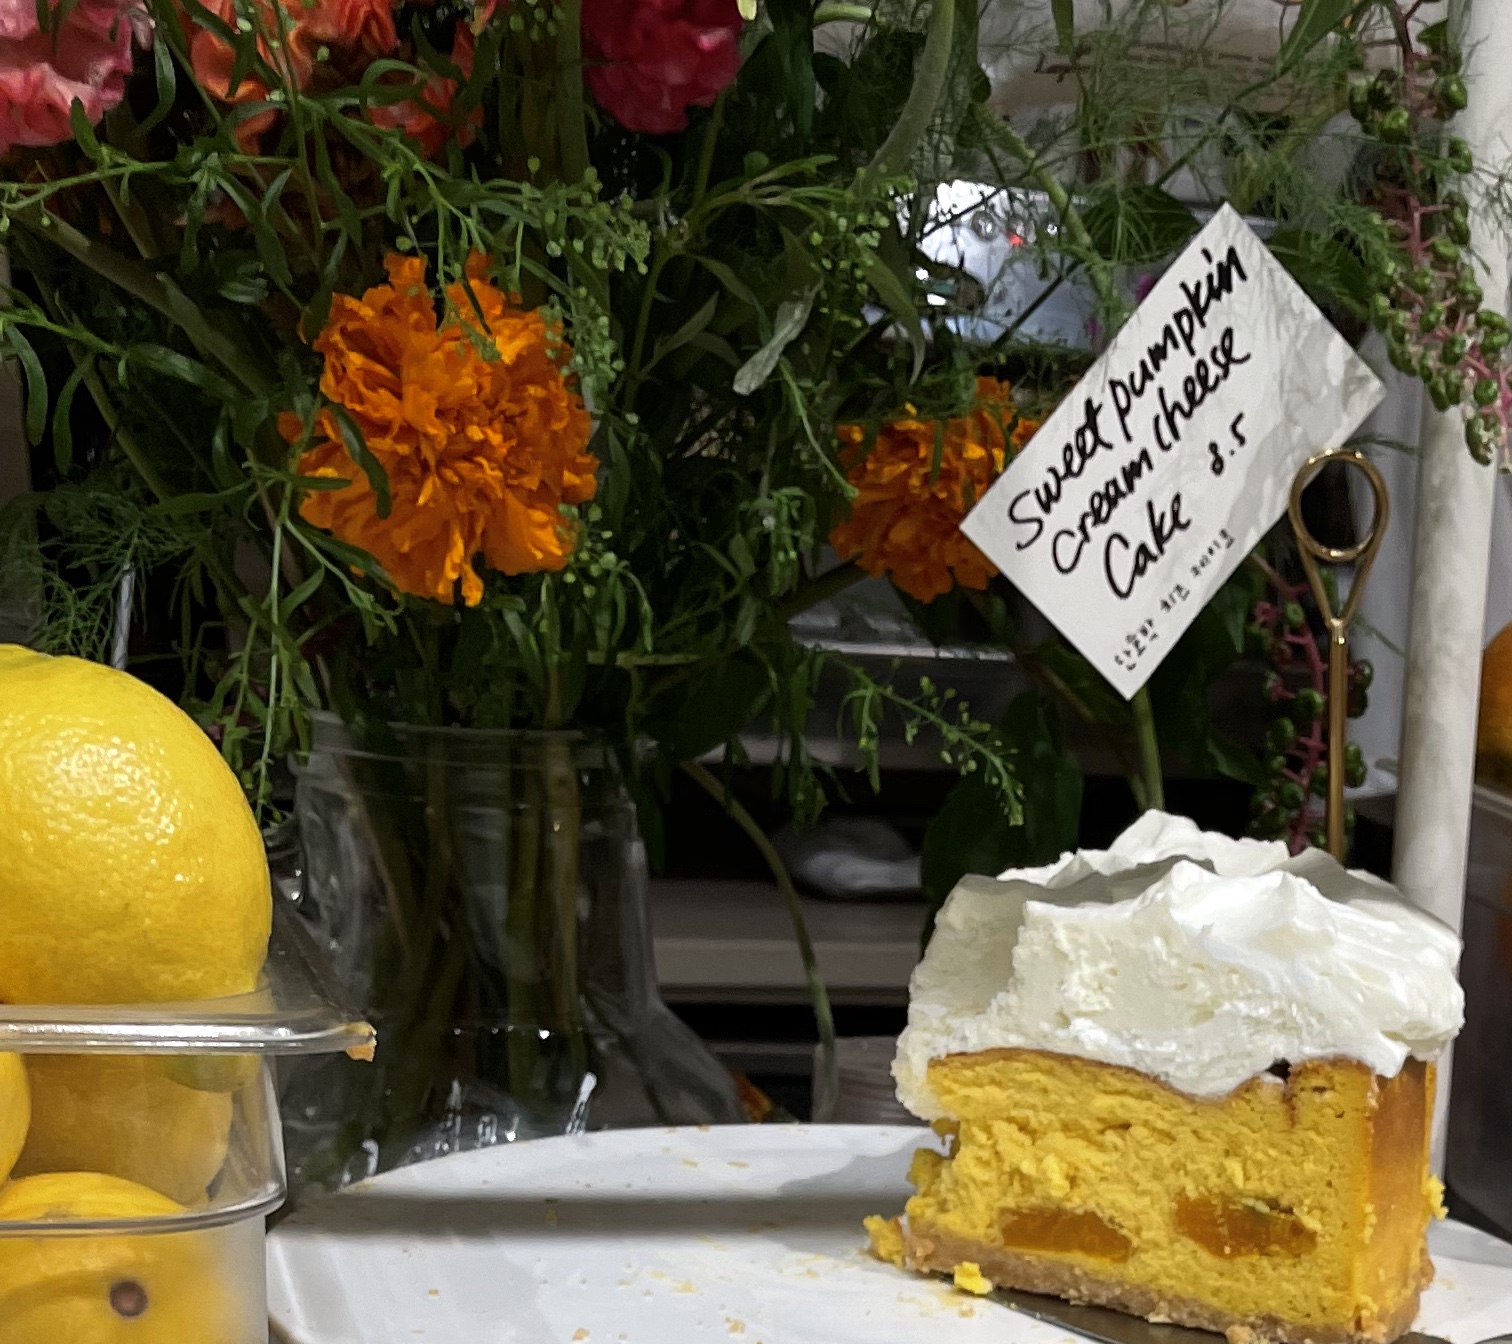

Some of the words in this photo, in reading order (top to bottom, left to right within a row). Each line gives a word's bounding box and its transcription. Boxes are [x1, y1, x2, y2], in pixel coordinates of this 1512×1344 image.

[1008, 396, 1113, 551] Sweet
[1109, 246, 1248, 441] pumpkin
[1104, 493, 1192, 599] Cake
[1208, 412, 1247, 475] 8.5
